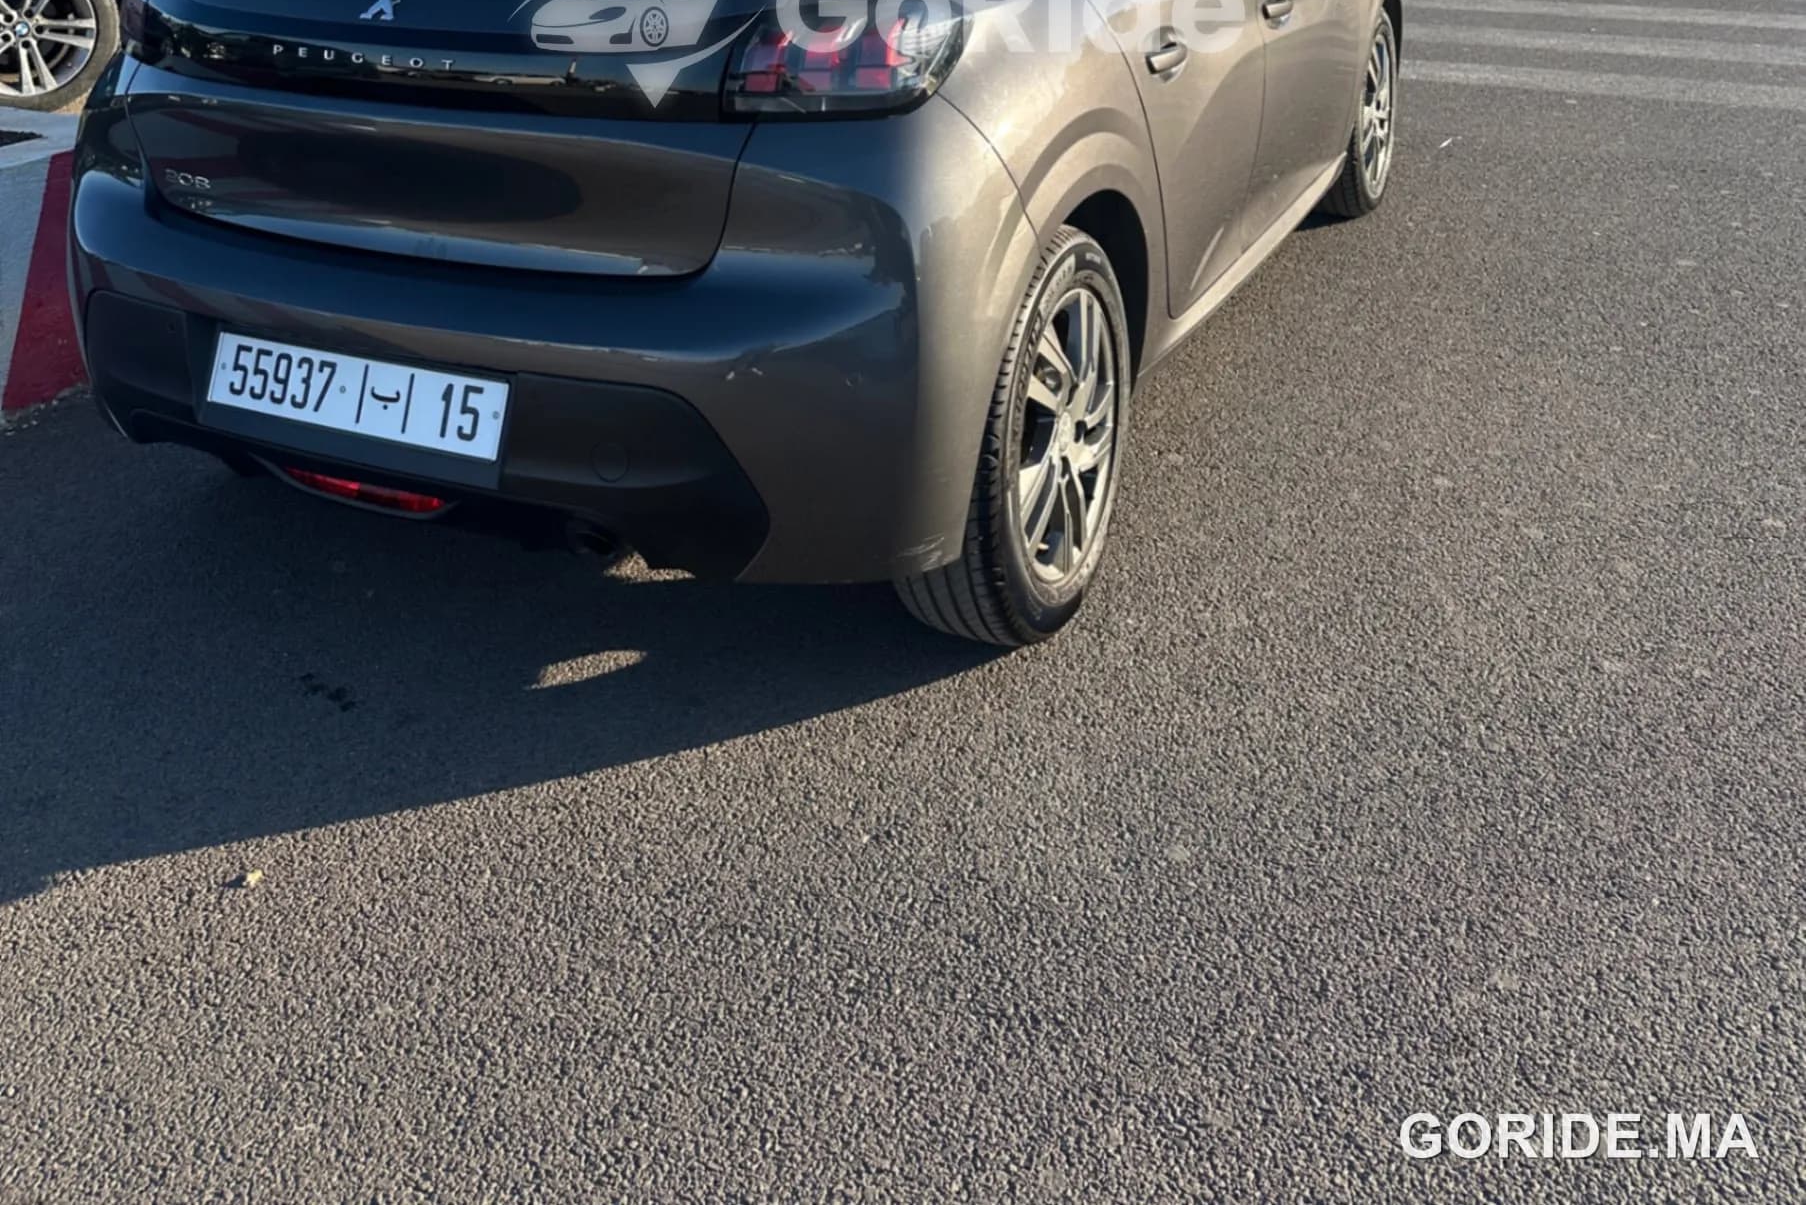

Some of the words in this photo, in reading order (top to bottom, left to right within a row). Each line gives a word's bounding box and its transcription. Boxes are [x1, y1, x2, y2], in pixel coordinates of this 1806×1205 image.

[273, 44, 454, 70] PEUGEOT
[229, 344, 337, 412] 55937
[440, 383, 484, 442] 15
